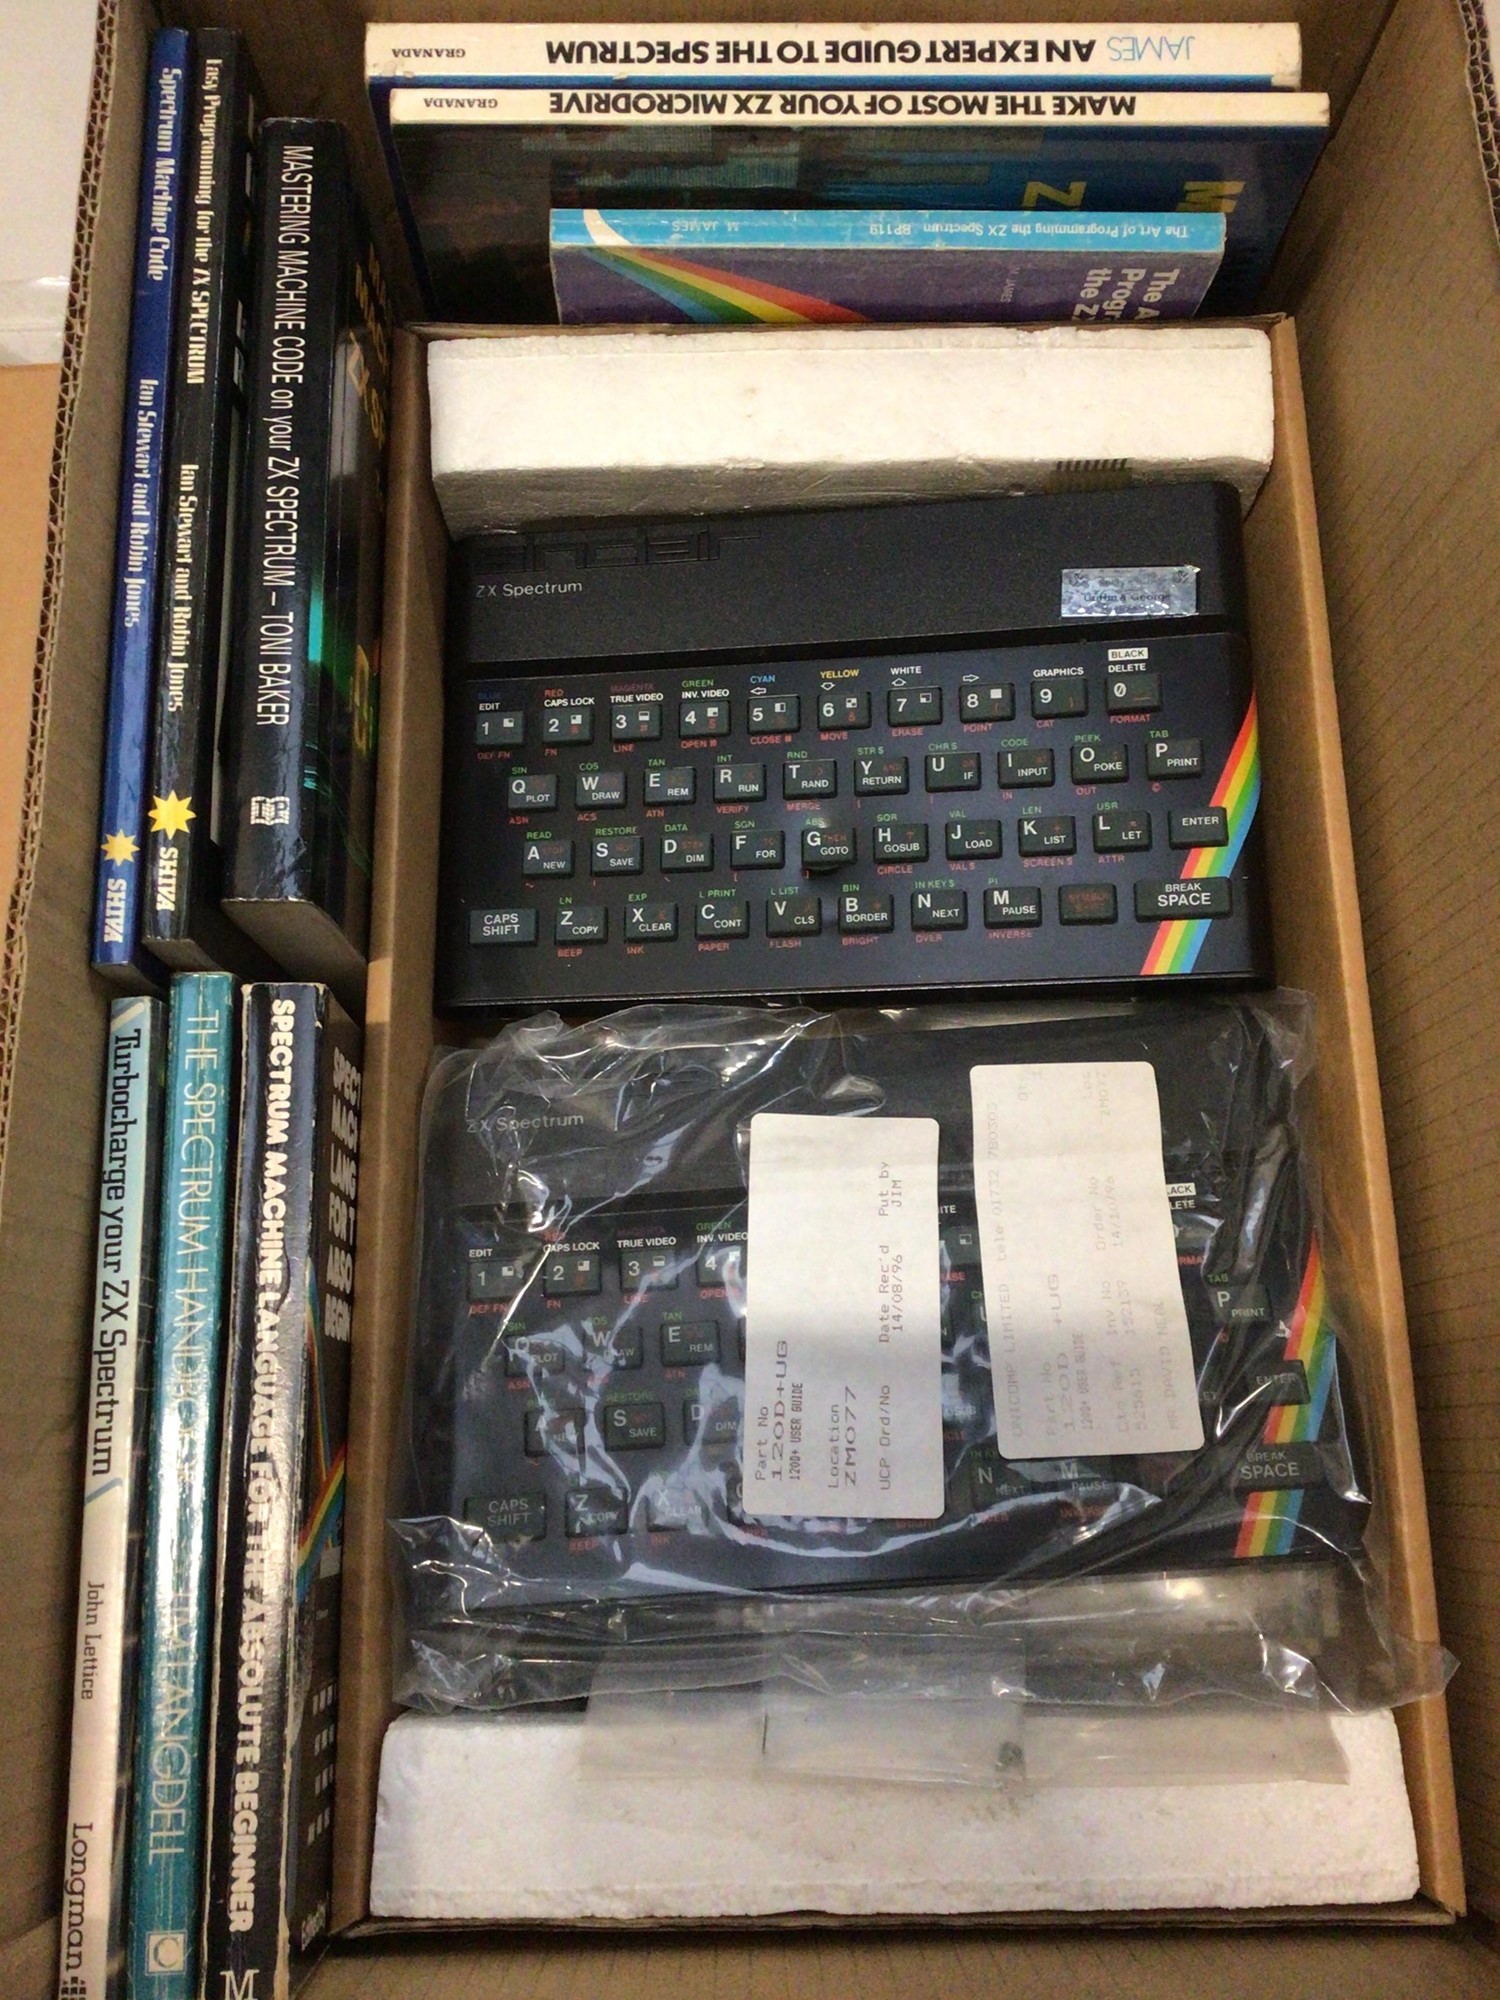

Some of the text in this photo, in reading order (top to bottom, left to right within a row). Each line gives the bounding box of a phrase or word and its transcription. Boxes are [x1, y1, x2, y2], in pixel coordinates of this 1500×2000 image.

[391, 48, 466, 59] GRANADA
[545, 35, 1195, 64] JAMES AN EXPERT GUIDE TO THE SPECTRUM
[423, 97, 499, 109] GRANADA
[549, 92, 1137, 116] MAKE THE MOST OF YOUR ZX MICRODRIVE
[194, 95, 221, 205] Programming
[146, 68, 182, 281] Spectrum Machine Code
[195, 210, 214, 234] for
[671, 220, 740, 232] M JAMES
[869, 220, 1188, 238] The Art of Programming the ZX Spectrum BP119
[193, 237, 211, 262] the
[1079, 268, 1112, 299] the
[1143, 268, 1180, 303] The
[186, 291, 210, 384] SPECTRUM
[256, 145, 313, 726] MASTERING MACHINE CODE on your ZX SPECTRUM TONI BAKER
[124, 379, 158, 627] Ian Stewart and Robin Jones
[167, 464, 199, 712] Ian Stewart and Robin Jones
[475, 581, 583, 597] ZX Spectrum
[1111, 649, 1145, 658] BLACK
[891, 666, 922, 675] WHITE
[1033, 666, 1084, 677] GRAPHICS
[1108, 663, 1146, 672] DELETE
[750, 675, 775, 684] CYAN
[820, 669, 859, 679] YELLOW
[682, 678, 714, 687] GREEN
[610, 692, 663, 703] TRUE VIDEO
[701, 688, 729, 698] VIDEO
[479, 702, 500, 711] EDIT
[544, 697, 595, 707] CAPS LOCK
[1094, 762, 1123, 772] POKE
[1167, 757, 1198, 767] PRINT
[964, 771, 974, 780] IF
[1018, 767, 1048, 777] INPUT
[802, 779, 829, 789] RAND
[862, 776, 902, 786] RETURN
[668, 788, 689, 797] REM
[738, 784, 759, 792] RUN
[526, 794, 550, 803] PLOT
[592, 791, 620, 800] DRAW
[1182, 816, 1219, 826] ENTER
[595, 826, 637, 836] RESTORE
[1123, 831, 1142, 840] LET
[965, 839, 993, 849] LOAD
[1044, 835, 1066, 845] LIST
[821, 846, 849, 855] GOTO
[884, 843, 920, 853] GOSUB
[686, 854, 704, 863] DIM
[756, 850, 776, 858] FOR
[543, 861, 566, 870] NEW
[610, 858, 634, 867] SAVE
[156, 847, 178, 911] SHIVA
[1165, 882, 1201, 892] BREAK
[1157, 893, 1211, 907] SPACE
[104, 878, 127, 943] SHIVA
[932, 908, 959, 918] NEXT
[1002, 905, 1036, 915] PAUSE
[484, 913, 519, 925] CAPS
[794, 915, 815, 925] CLS
[846, 912, 888, 922] BORDER
[639, 922, 672, 932] CLEAR
[714, 919, 742, 928] CONT
[483, 924, 520, 936] SHIFT
[572, 926, 599, 935] COPY
[185, 1009, 219, 1070] THE
[496, 1113, 584, 1132] Spectrum
[176, 1082, 217, 1255] SPECTRUM
[878, 1161, 889, 1216] Put by
[892, 1179, 902, 1207] JIM
[617, 1236, 676, 1248] TRUE VIDEO
[92, 1028, 141, 1476] Turbocharge your ZX Spectrum
[469, 1248, 493, 1257] EDIT
[879, 1245, 890, 1343] Date Rec'd
[891, 1254, 904, 1332] 14/08/96
[1001, 1283, 1016, 1353] LIMITED
[1231, 1307, 1265, 1318] PRINT
[792, 1382, 803, 1412] GUIDE
[771, 1340, 788, 1481] 120D+UG
[629, 1428, 657, 1437] SAVE
[790, 1419, 802, 1443] USER
[845, 1386, 856, 1486] ZM077
[755, 1406, 768, 1480] Part No
[880, 1385, 890, 1490] UCP Ord/No
[828, 1403, 839, 1488] Location
[228, 999, 296, 1932] SPECTRUM MACHINE LANGUAGE FOR THE ABSOLUTE BEGINNER
[1241, 1463, 1299, 1479] SPACE
[488, 1500, 529, 1512] CAPS
[81, 1581, 104, 1700] John Lettice
[149, 1662, 192, 1865] LANGDELL
[65, 1822, 92, 1971] Longman
